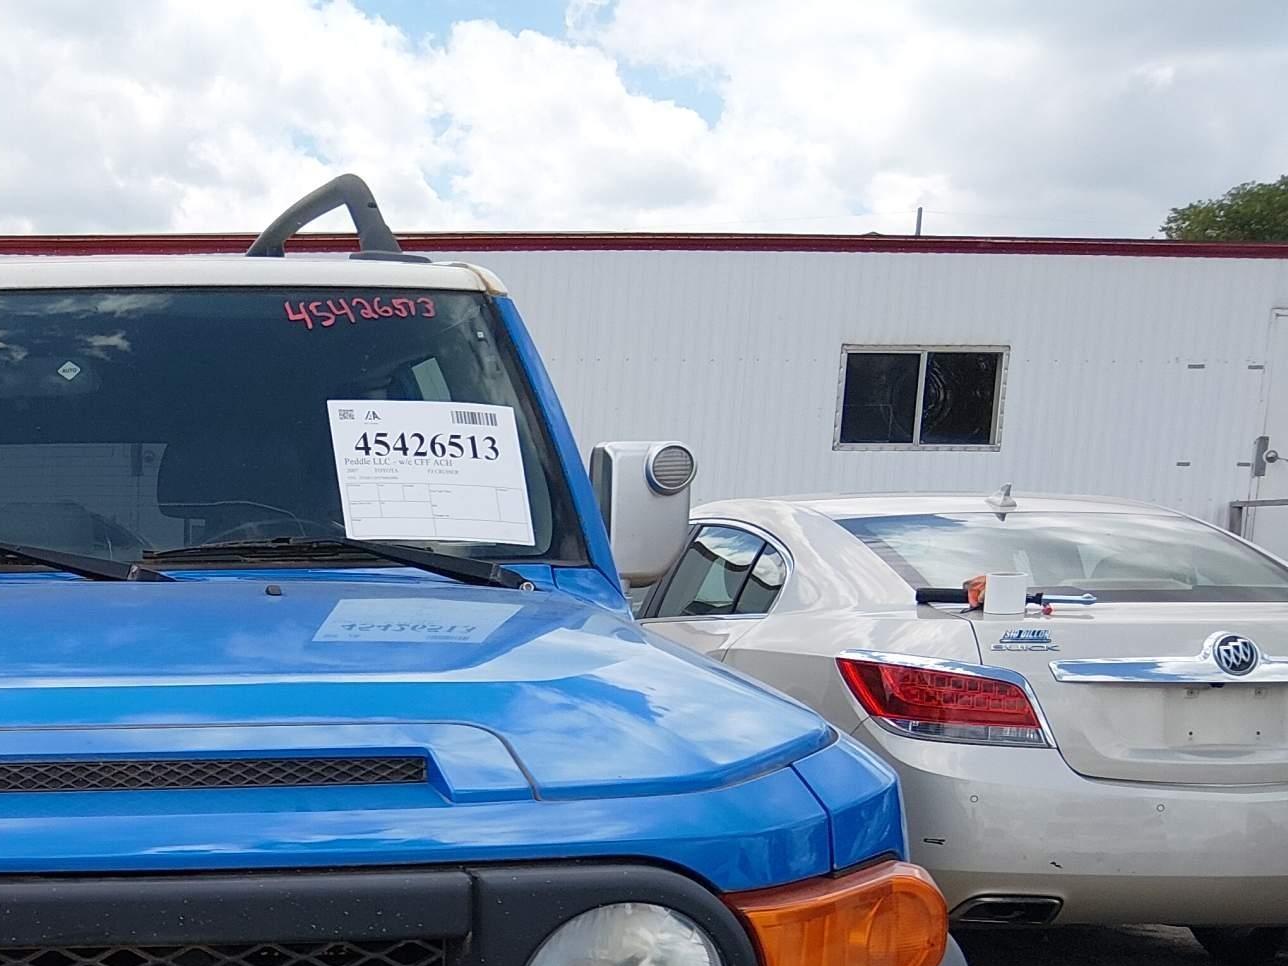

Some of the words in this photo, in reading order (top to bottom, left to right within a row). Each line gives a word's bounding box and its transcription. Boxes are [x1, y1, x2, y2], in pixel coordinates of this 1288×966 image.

[284, 297, 436, 330] 45426513
[354, 431, 500, 461] 45426513
[344, 457, 371, 466] Peddle
[373, 458, 391, 466] LLC
[991, 644, 1061, 652] BUICK
